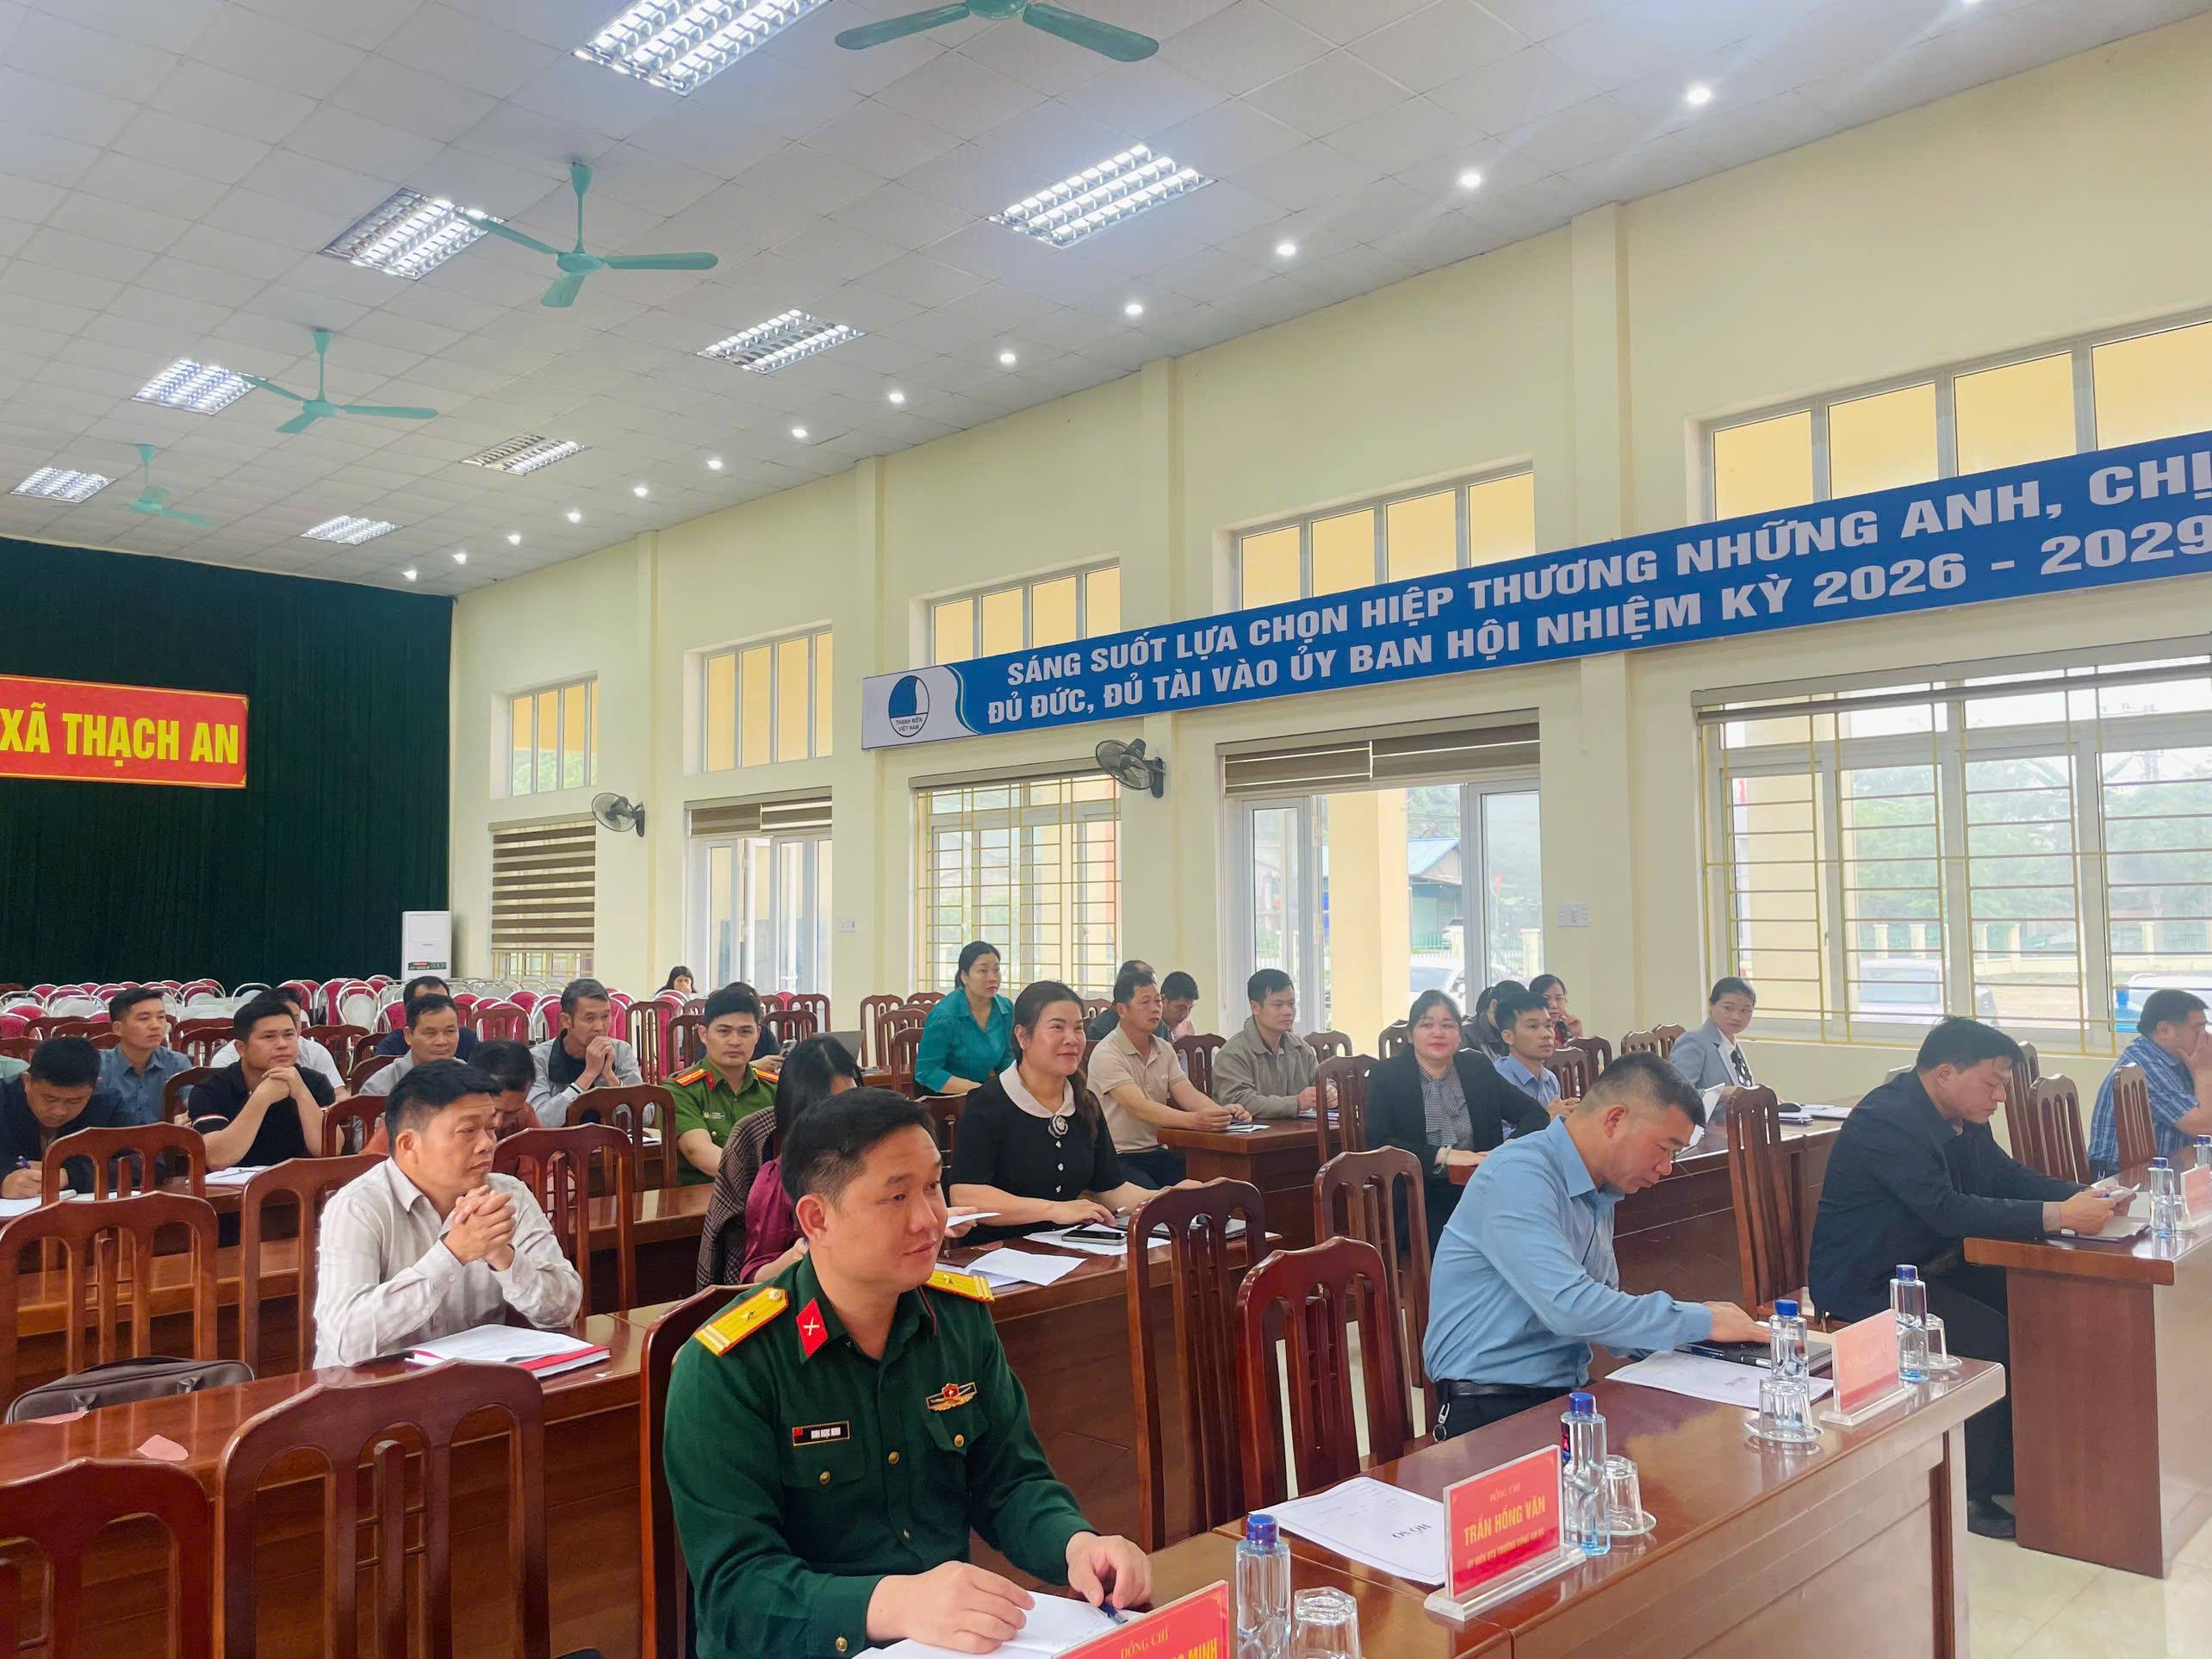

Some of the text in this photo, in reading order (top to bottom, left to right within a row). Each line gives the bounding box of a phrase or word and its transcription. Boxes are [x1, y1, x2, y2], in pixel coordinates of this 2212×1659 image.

[987, 515, 2212, 724] ĐỦ ĐỨC, ĐỦ TÀI VÀO ỦY BAN HỘI NHIỆM KỲ 2026 - 2029
[1008, 450, 2212, 686] SÁNG SUỐT LỰA CHỌN HIỆP THƯƠNG NHỮNG ANH, CHỊ
[0, 702, 239, 767] XÃ THẠCH AN
